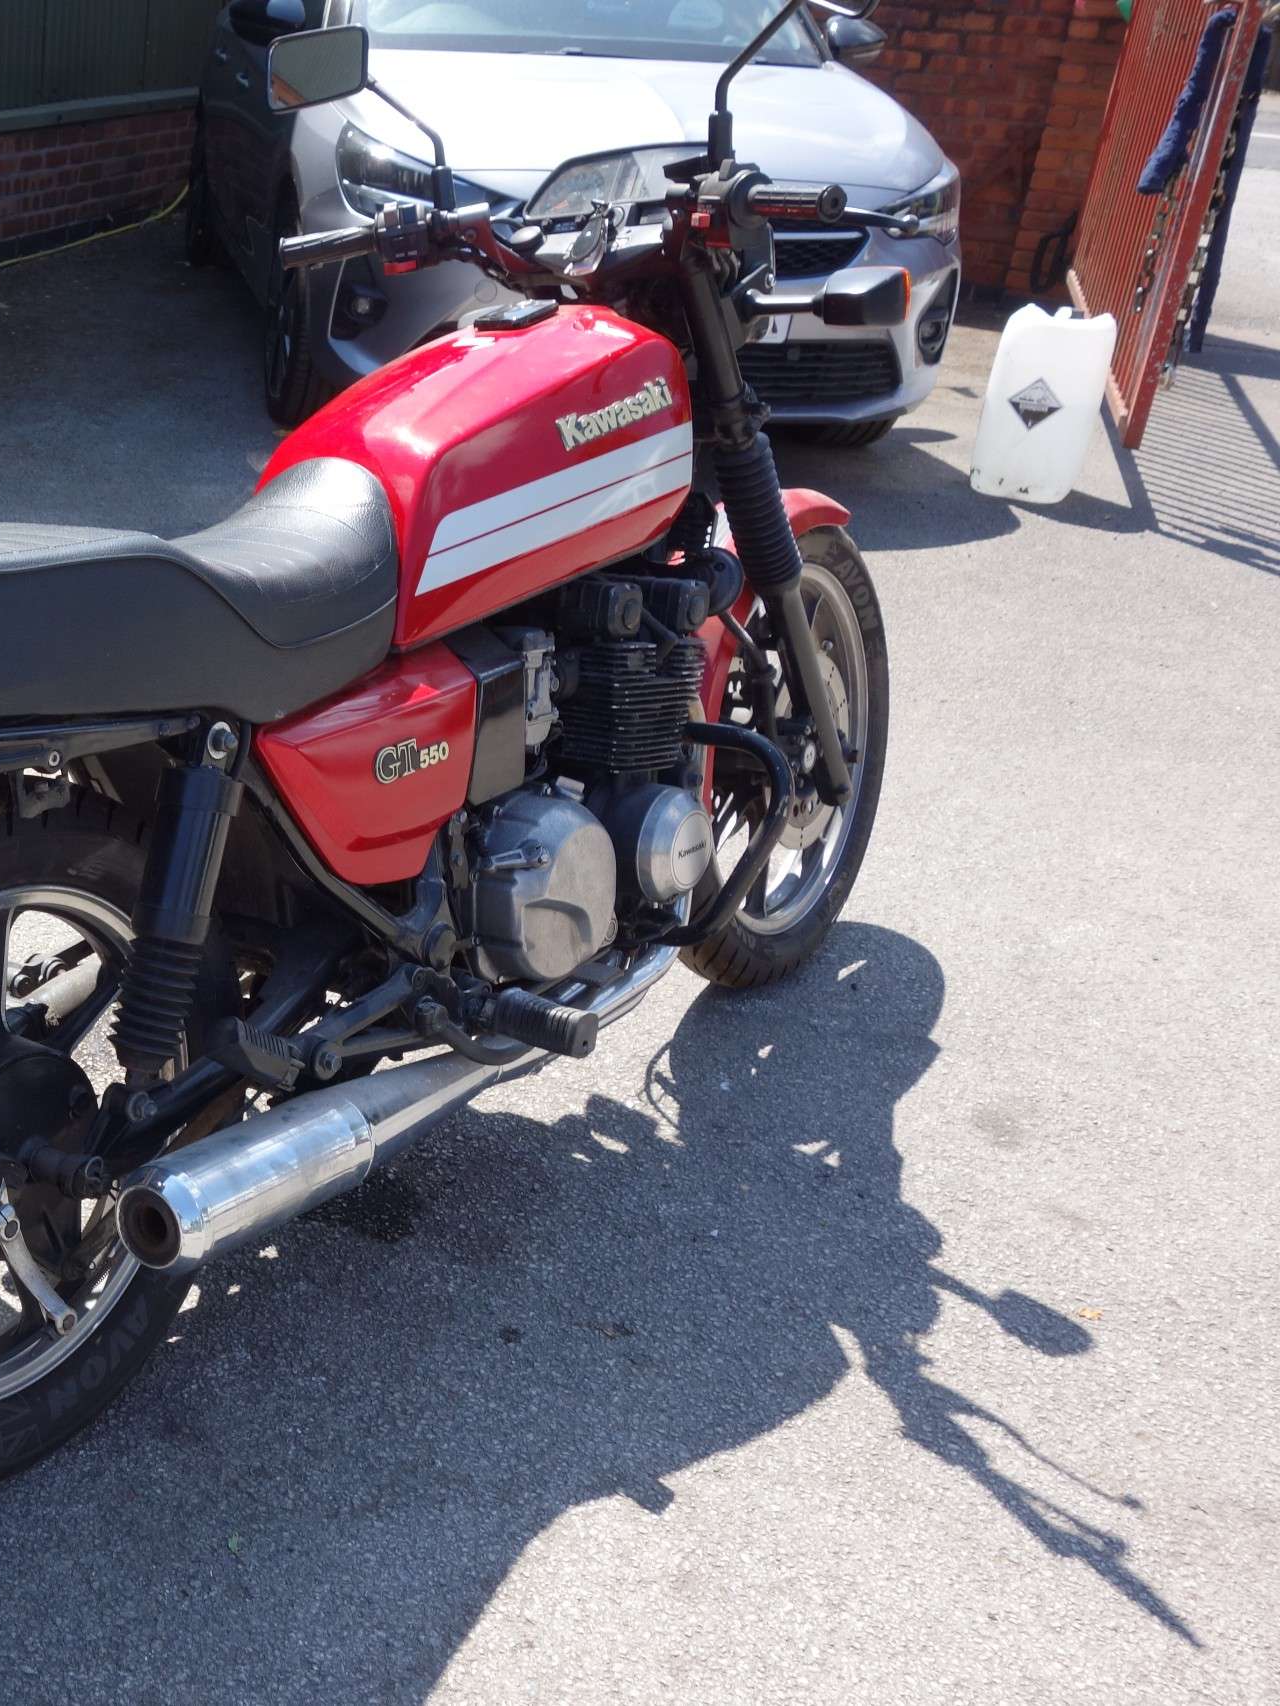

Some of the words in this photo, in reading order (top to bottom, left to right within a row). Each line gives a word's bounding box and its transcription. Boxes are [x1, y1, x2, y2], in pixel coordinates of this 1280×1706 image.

[555, 376, 672, 451] Kawasaki
[834, 557, 879, 632] AVON
[375, 738, 418, 784] GT
[419, 741, 449, 769] 550
[678, 839, 707, 859] Kawasaki
[47, 1293, 149, 1419] AVON
